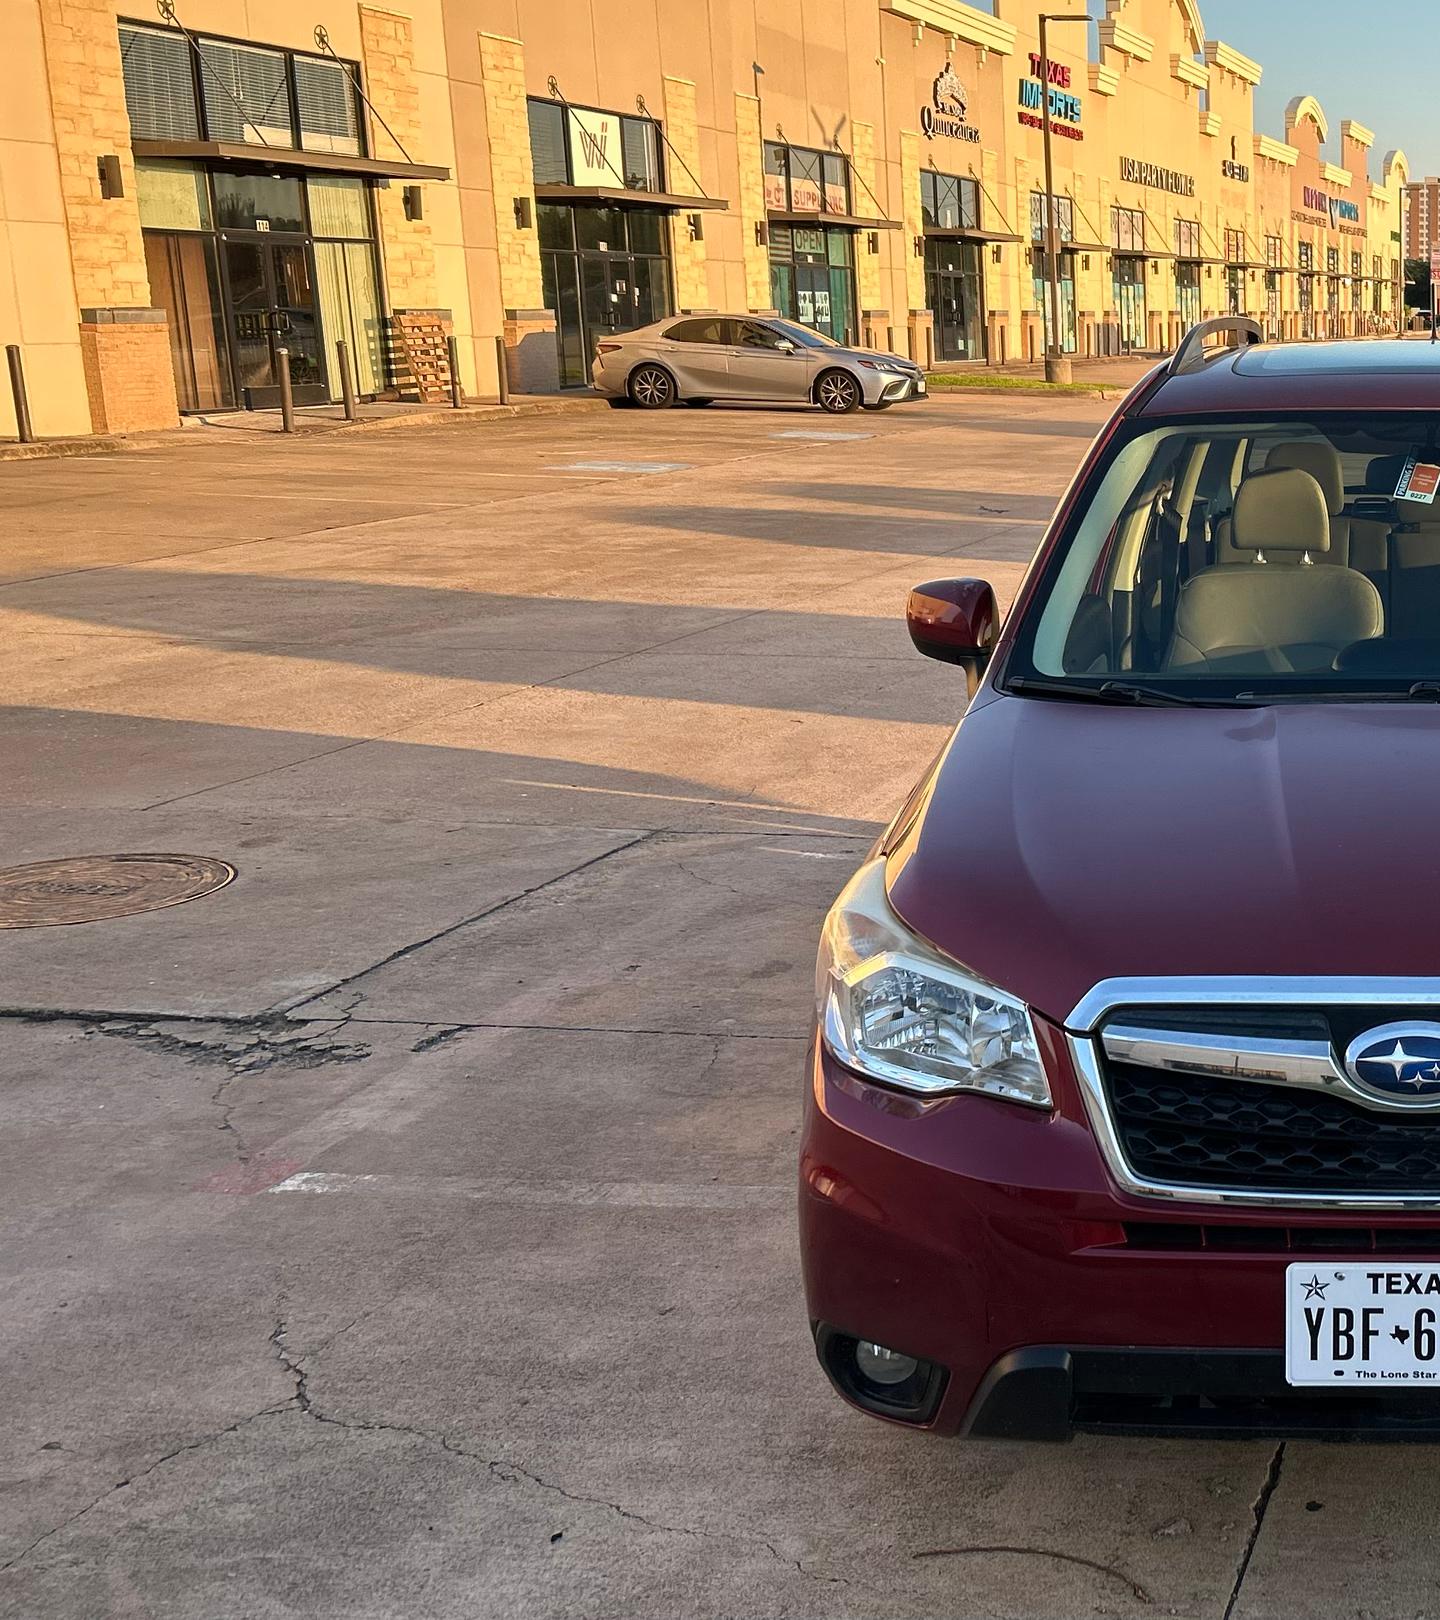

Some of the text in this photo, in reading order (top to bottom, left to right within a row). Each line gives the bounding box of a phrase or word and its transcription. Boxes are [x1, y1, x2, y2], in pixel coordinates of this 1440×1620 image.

[1028, 53, 1071, 88] TXAS
[1121, 157, 1140, 181] USA
[1141, 162, 1167, 190] PARTY
[795, 230, 823, 250] OPEN
[1355, 1370, 1379, 1379] The
[1381, 1370, 1409, 1379] Lone
[1413, 1370, 1438, 1379] Star
